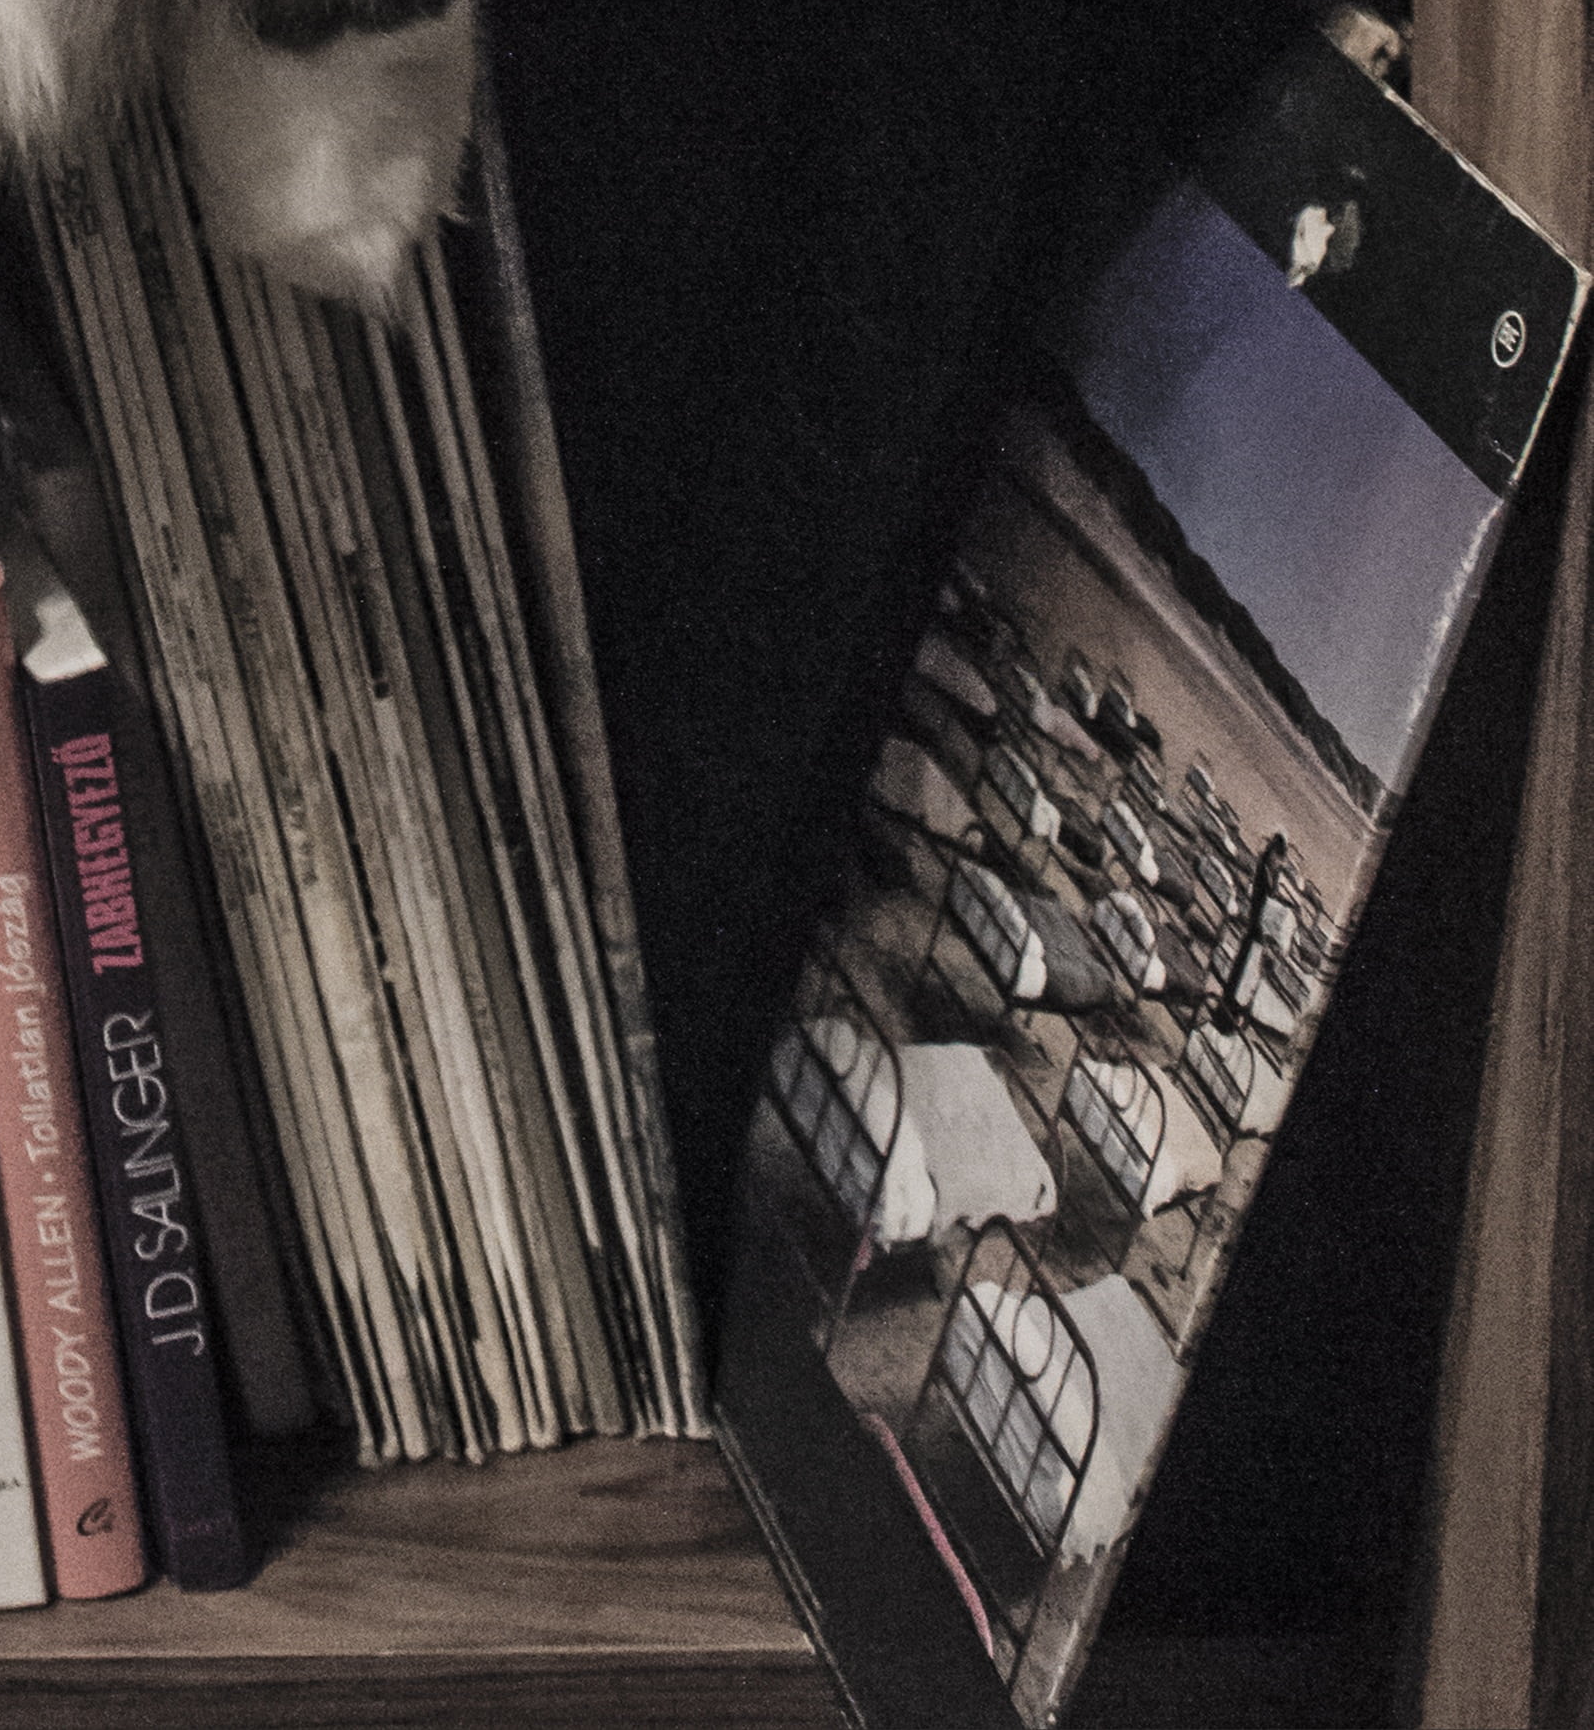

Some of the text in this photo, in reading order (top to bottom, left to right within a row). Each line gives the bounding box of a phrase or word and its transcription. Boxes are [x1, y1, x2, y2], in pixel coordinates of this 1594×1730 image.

[11, 1005, 104, 1462] WOODY ALLEN Tollatlan
[49, 732, 189, 1263] SALINGER ZABHEGYEZŐ
